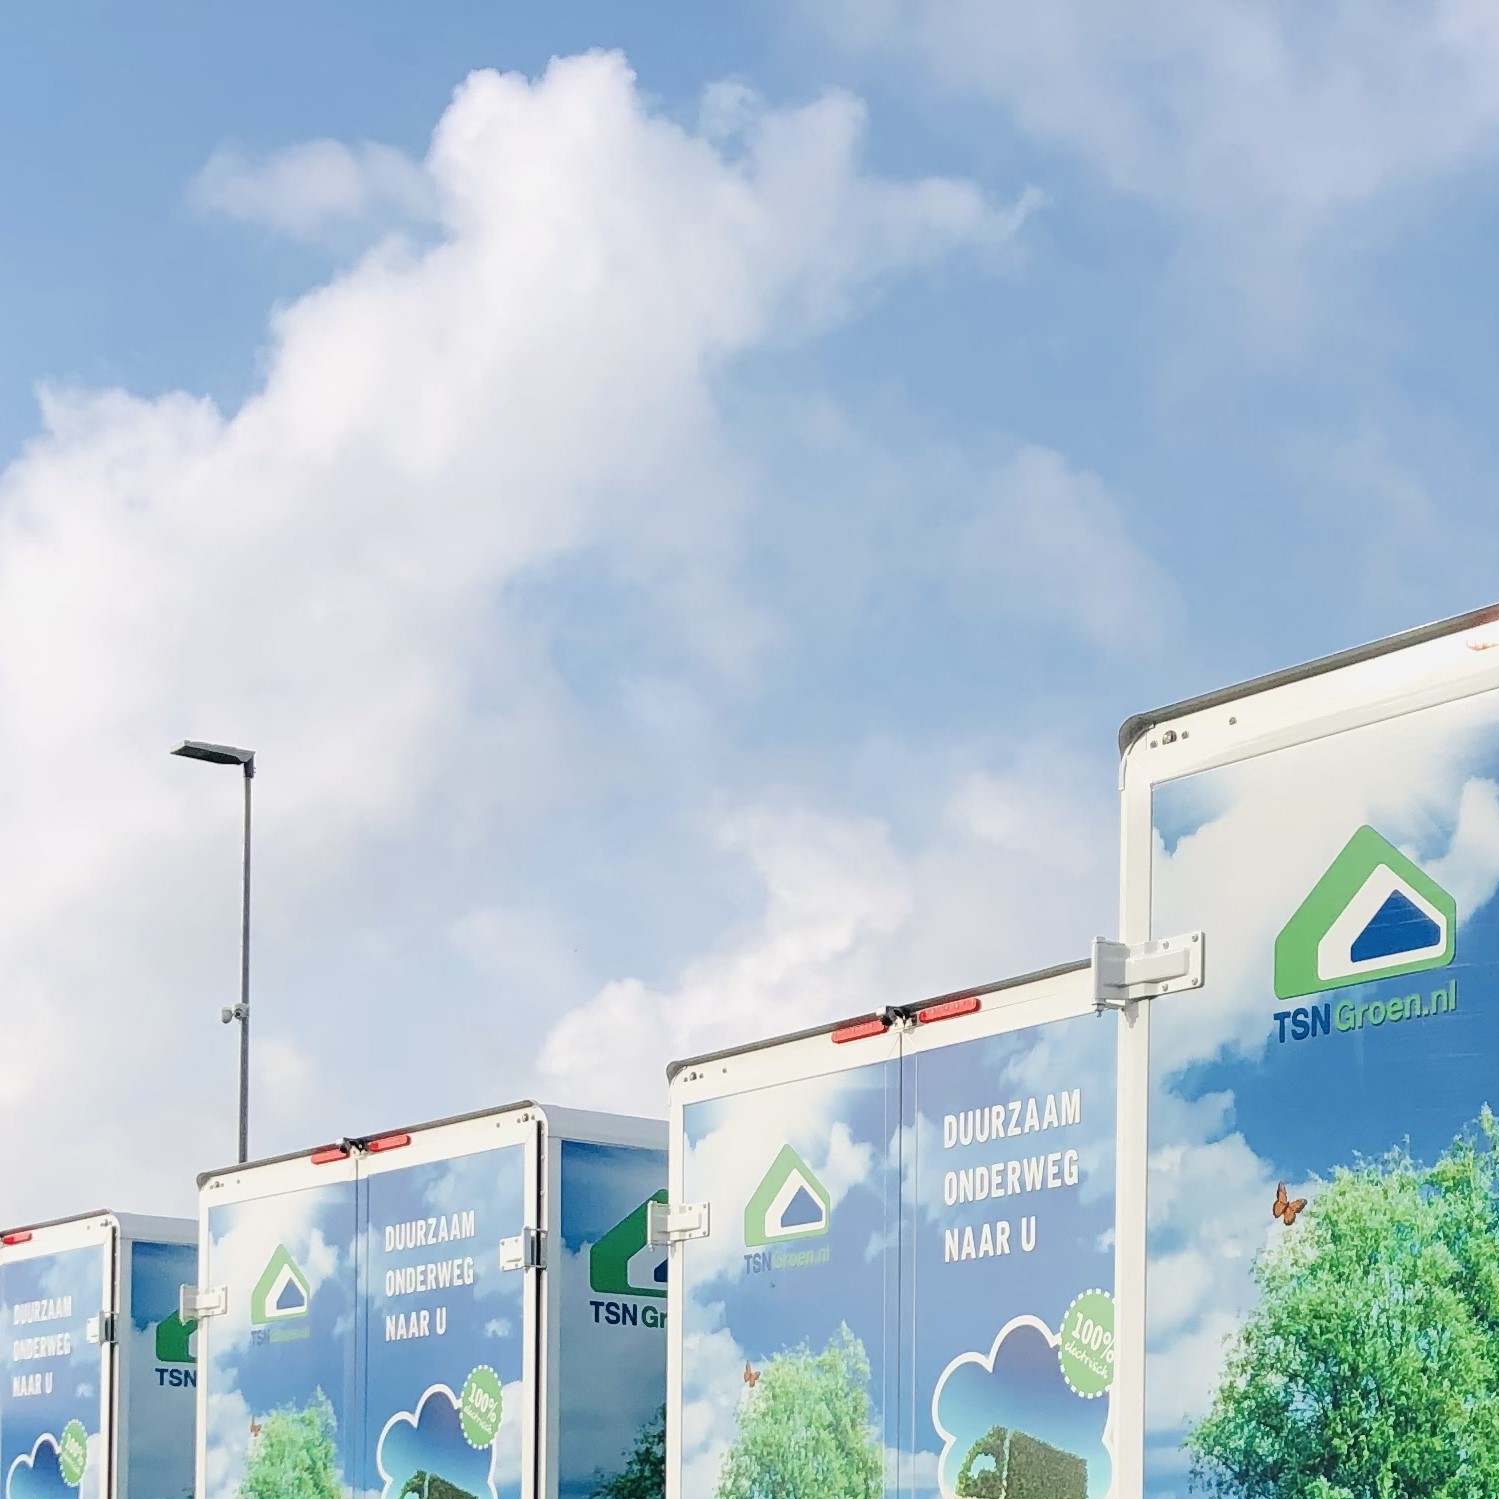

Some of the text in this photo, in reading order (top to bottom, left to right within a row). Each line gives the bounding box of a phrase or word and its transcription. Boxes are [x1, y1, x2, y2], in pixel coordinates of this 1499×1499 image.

[943, 1088, 1082, 1150] DUURZAAM
[944, 1149, 1080, 1207] ONDERWEG
[385, 1210, 475, 1253] DUURZAAM
[944, 1216, 1037, 1264] NAAR U
[385, 1257, 475, 1298] ONDERWEG
[385, 1307, 447, 1342] NAAR U
[1071, 1311, 1114, 1364] 100%
[12, 1372, 53, 1398] NAAR U
[468, 1382, 498, 1423] 100%
